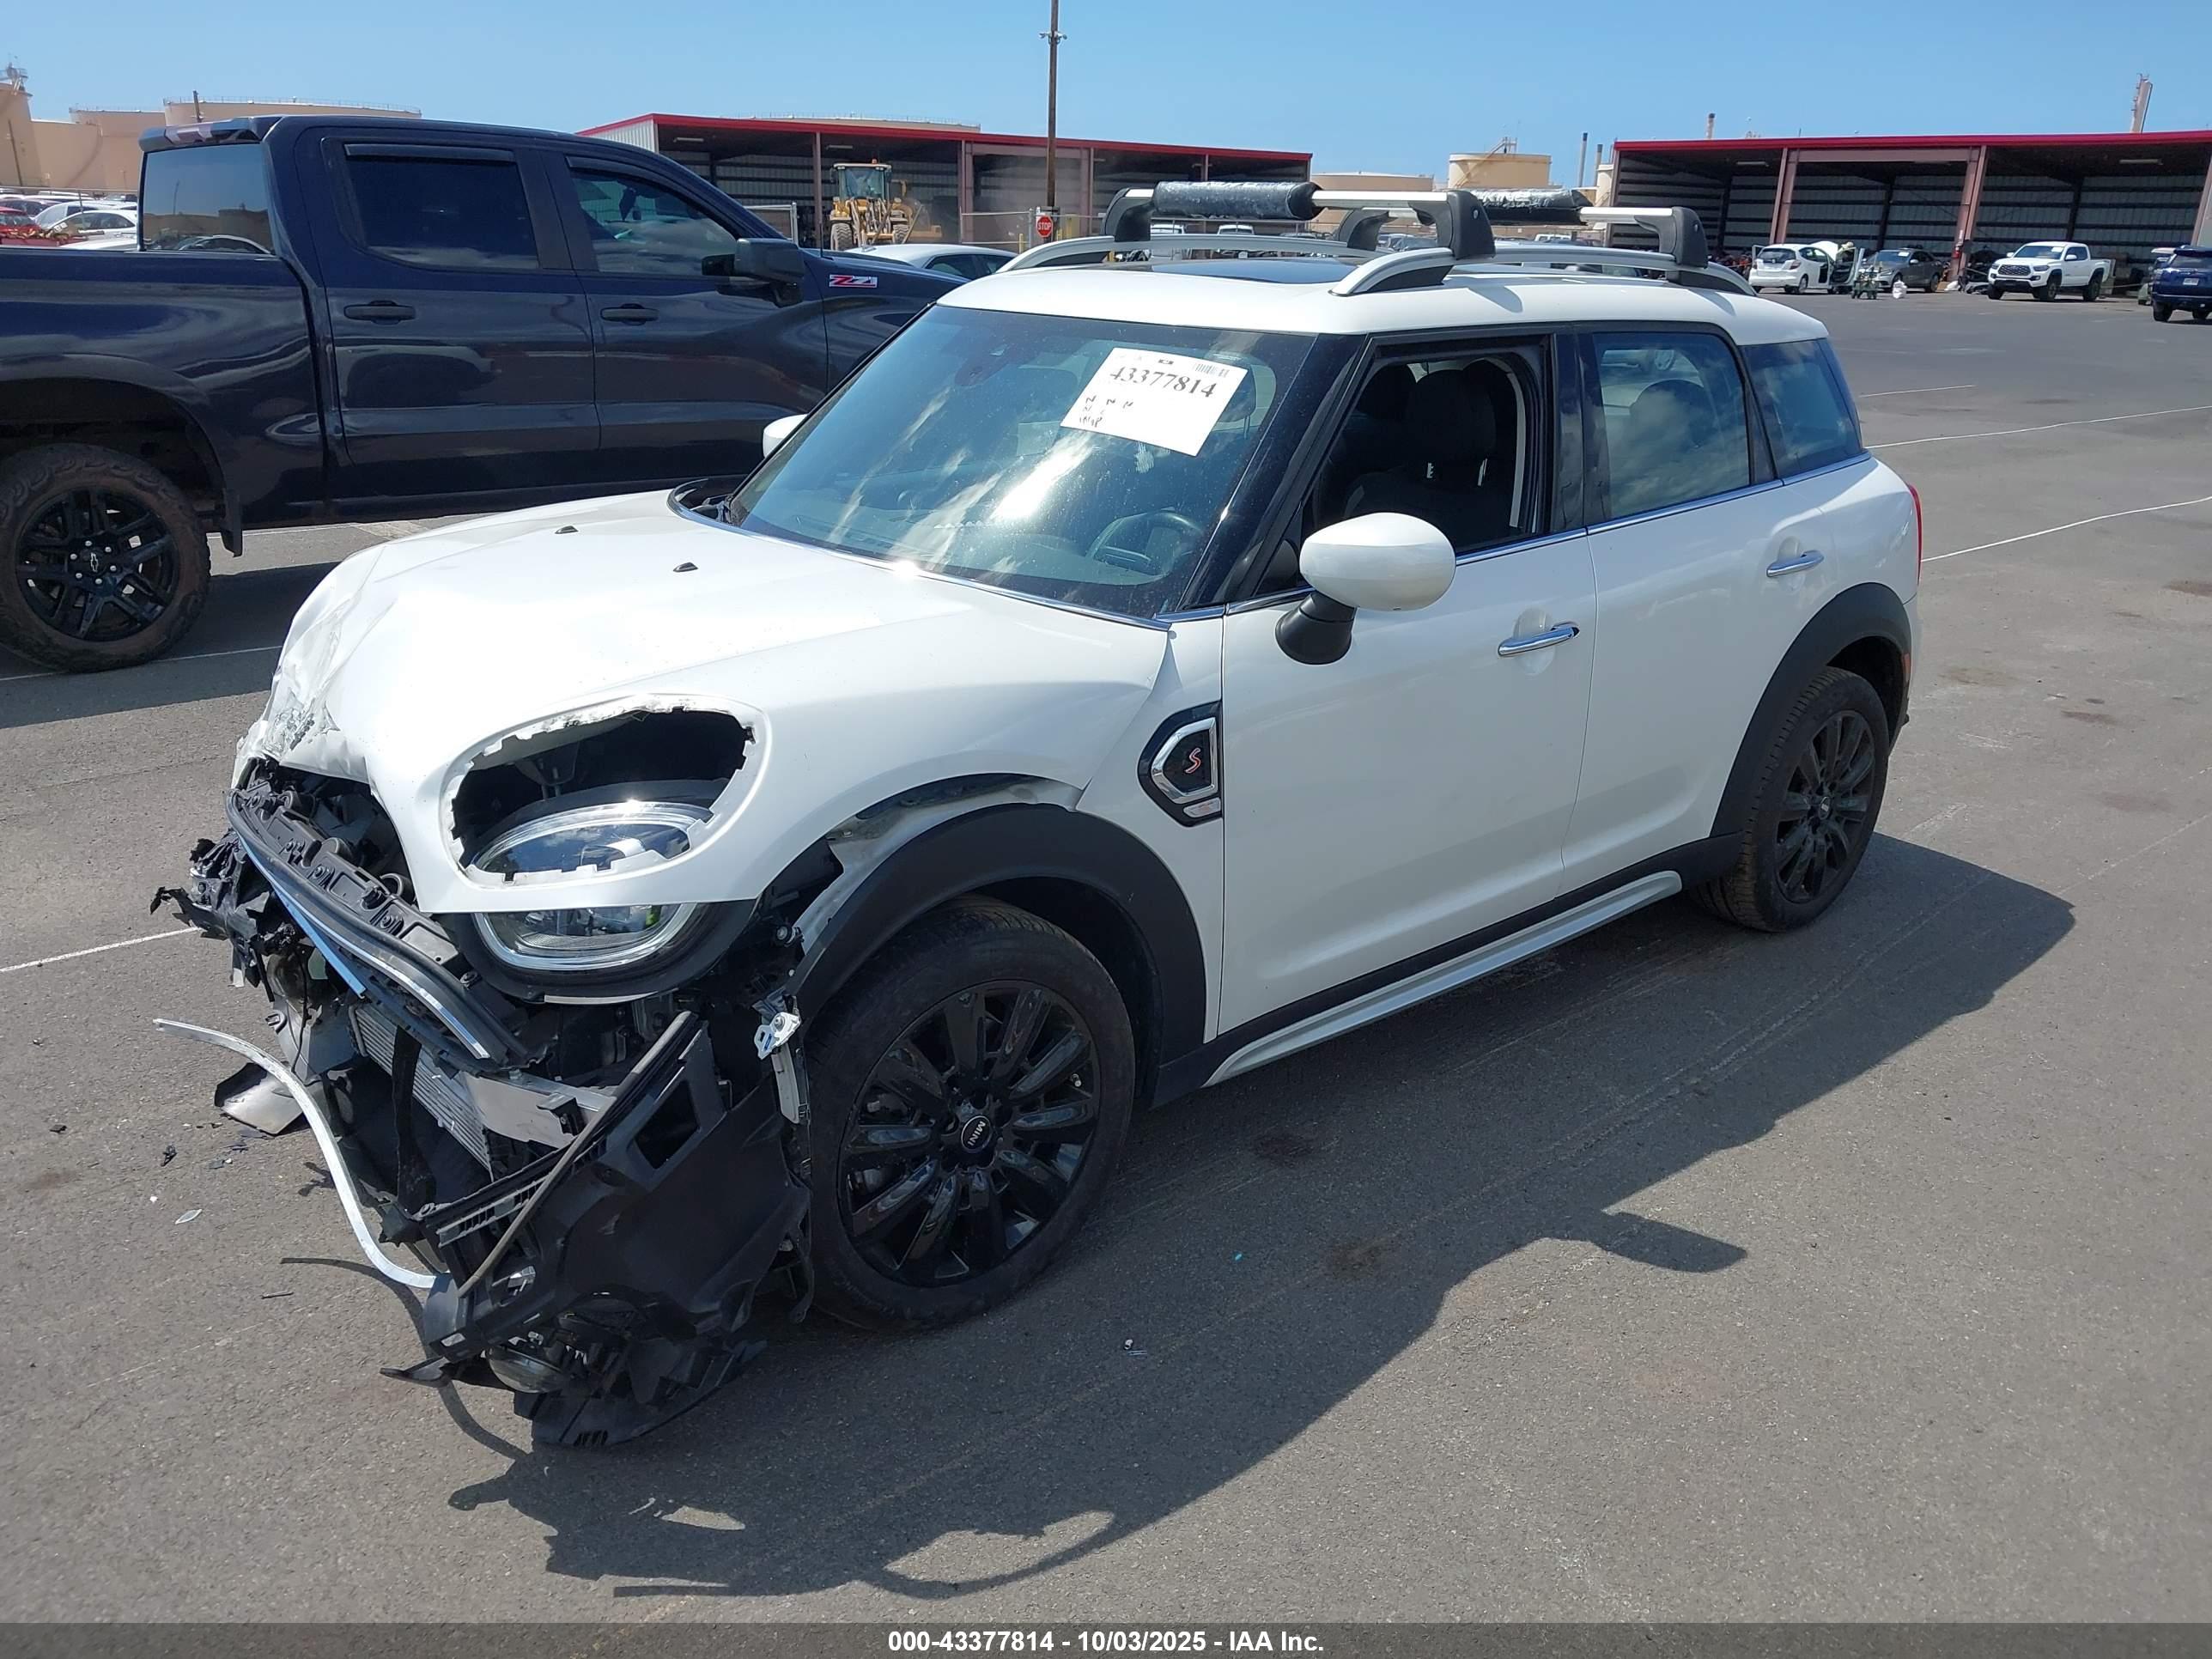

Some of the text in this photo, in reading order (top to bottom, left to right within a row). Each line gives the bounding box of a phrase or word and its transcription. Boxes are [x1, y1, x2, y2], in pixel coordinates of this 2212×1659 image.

[1037, 222, 1052, 230] STOP
[1109, 366, 1218, 398] 43377814
[1184, 747, 1201, 774] S
[967, 1121, 987, 1146] MINI
